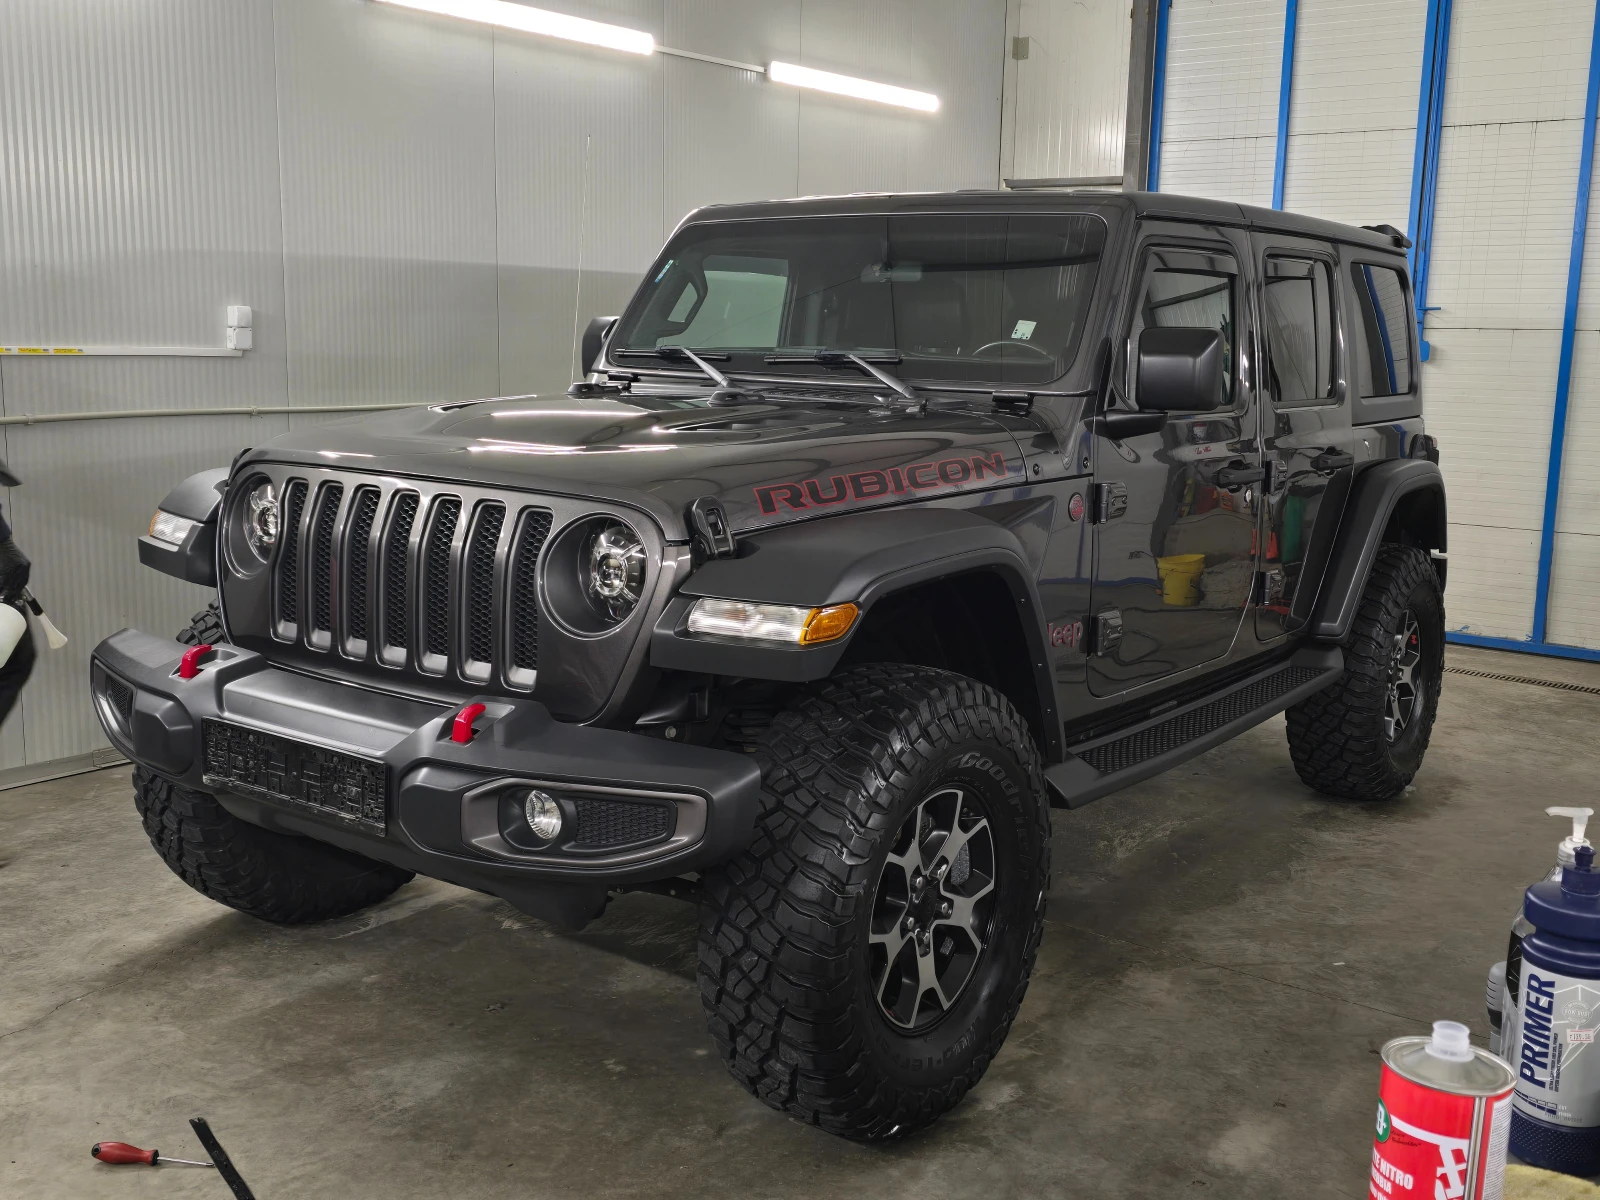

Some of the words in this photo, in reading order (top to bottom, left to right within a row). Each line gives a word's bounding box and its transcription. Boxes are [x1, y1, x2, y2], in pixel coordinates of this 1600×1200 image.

[753, 452, 1008, 516] RUBICON
[1047, 621, 1084, 648] Jeep
[1519, 973, 1556, 1089] PRIMER
[1380, 1158, 1414, 1190] NITRO
